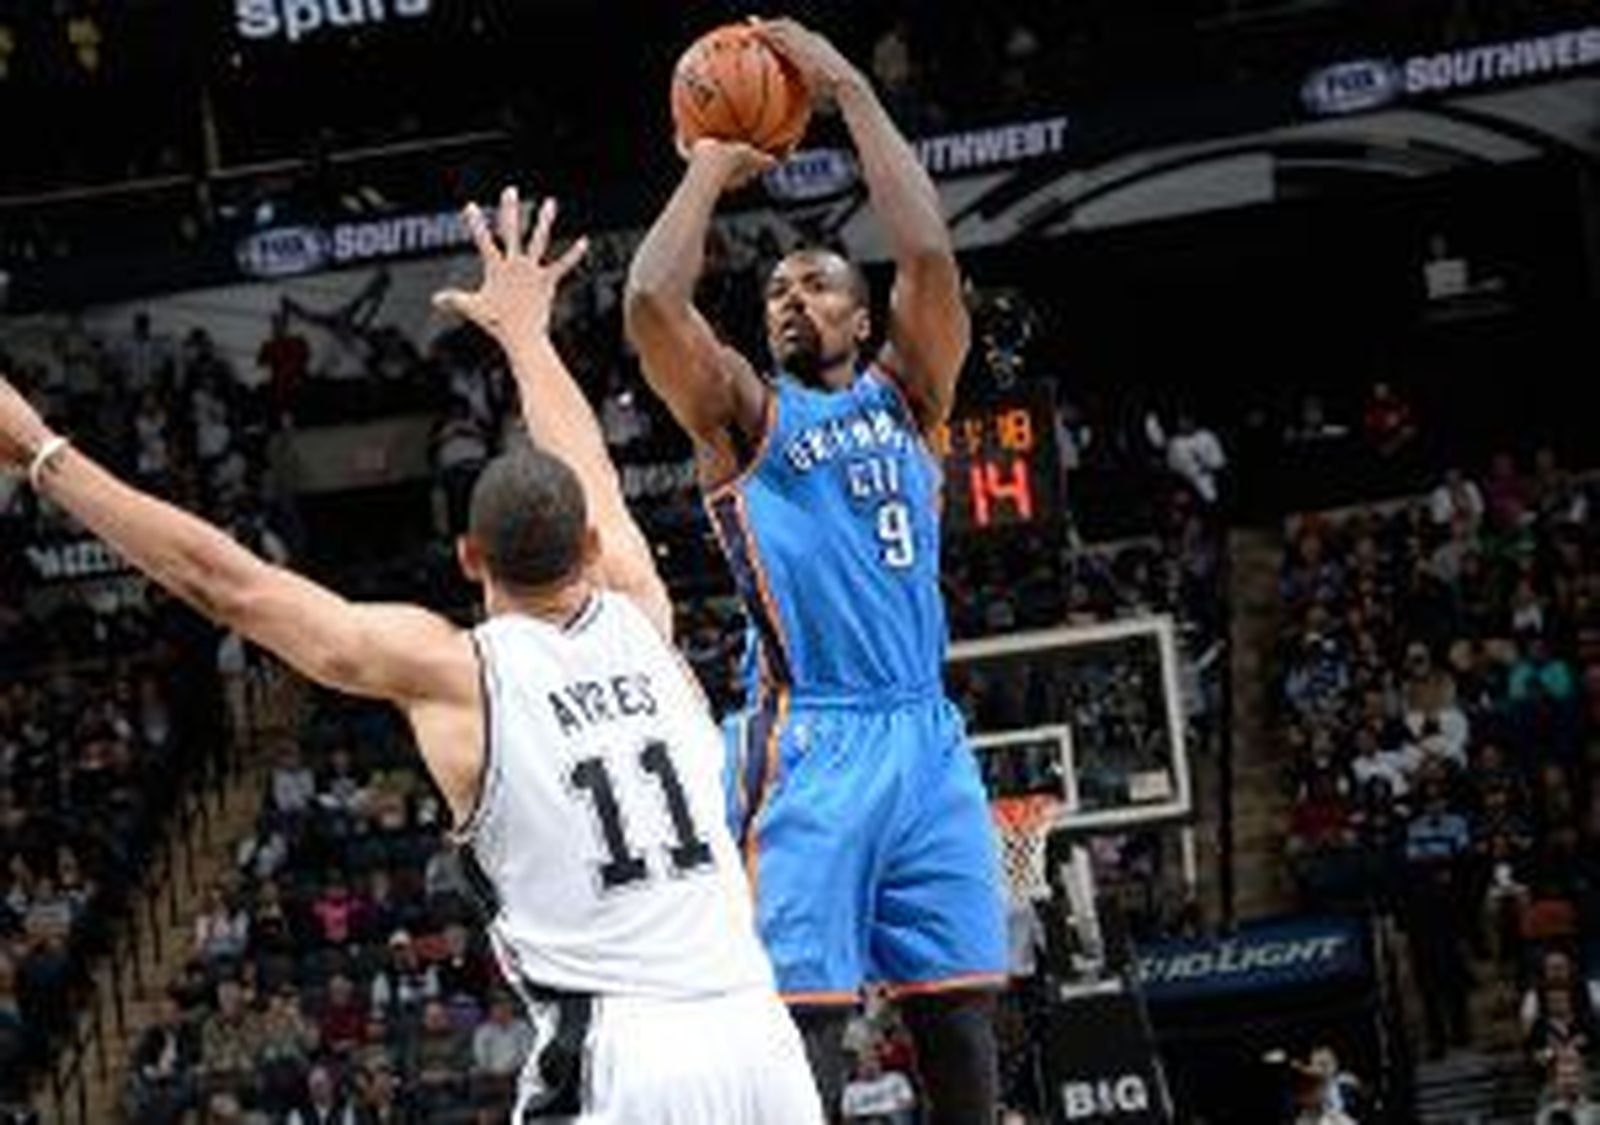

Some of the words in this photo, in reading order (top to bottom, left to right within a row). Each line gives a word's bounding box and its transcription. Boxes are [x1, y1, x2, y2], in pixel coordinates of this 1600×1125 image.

[1405, 27, 1600, 93] SOUTHWES
[973, 458, 1032, 528] 14
[878, 500, 915, 567] 9
[547, 673, 658, 738] AYRES
[570, 740, 715, 892] 11
